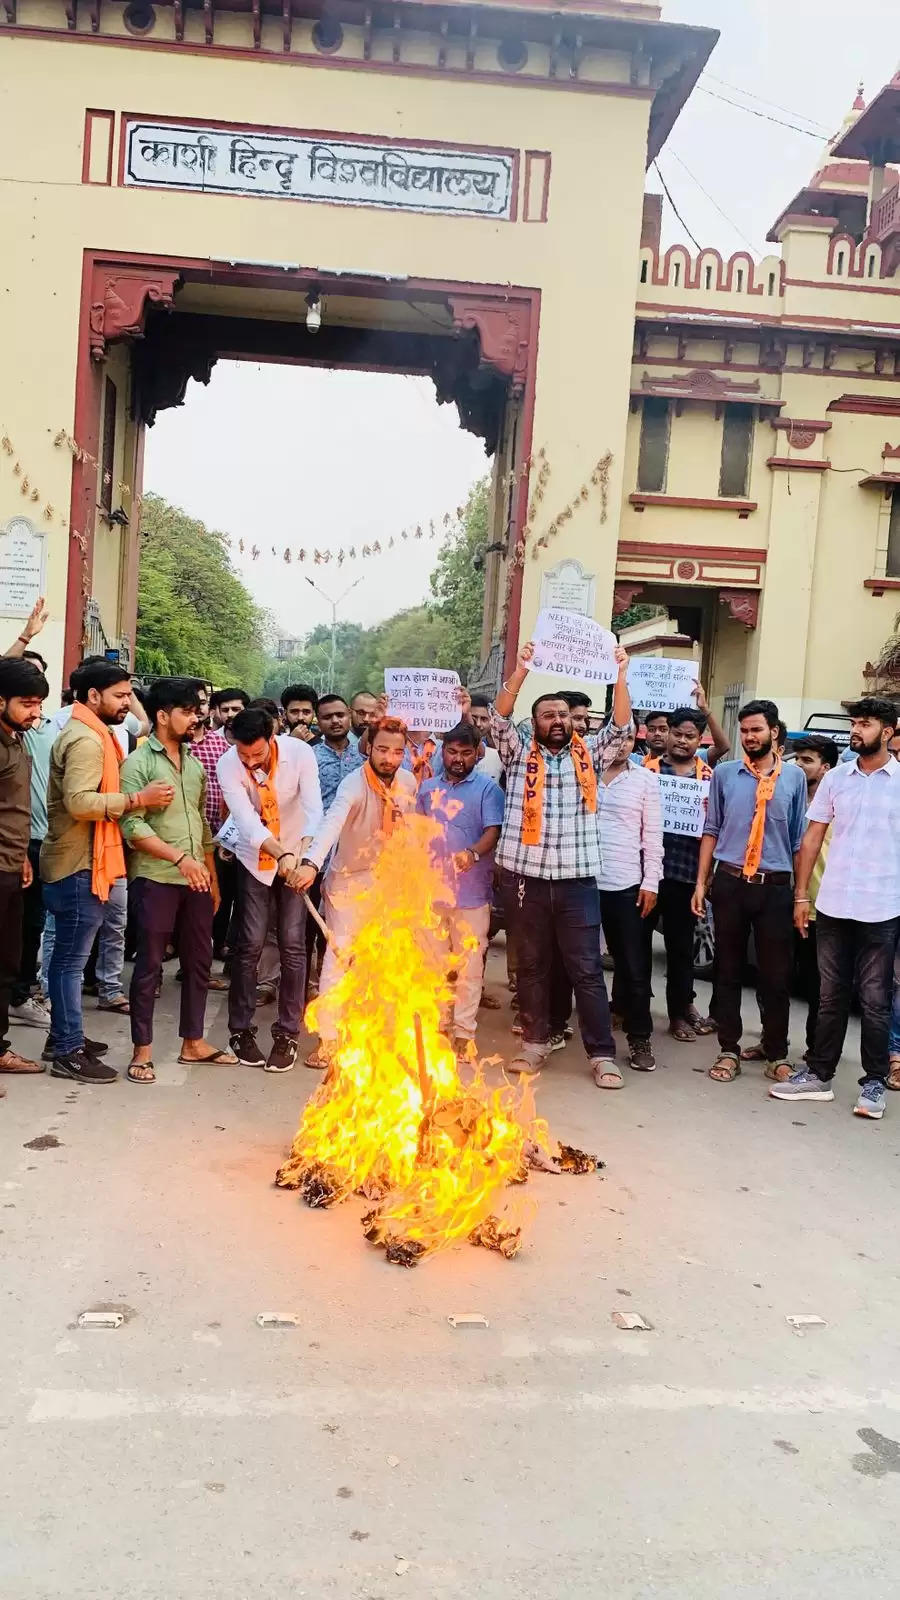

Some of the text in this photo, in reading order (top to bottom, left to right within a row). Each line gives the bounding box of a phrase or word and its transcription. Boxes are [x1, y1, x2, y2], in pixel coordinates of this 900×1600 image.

[139, 134, 499, 199] काशी हिन्दू विश्वविद्यालय
[545, 661, 613, 681] ABVP BHU
[392, 674, 411, 682] NTA
[637, 699, 666, 709] ABVP
[434, 718, 457, 729] BHU
[526, 750, 539, 802] ABVP
[673, 821, 699, 833] BHU
